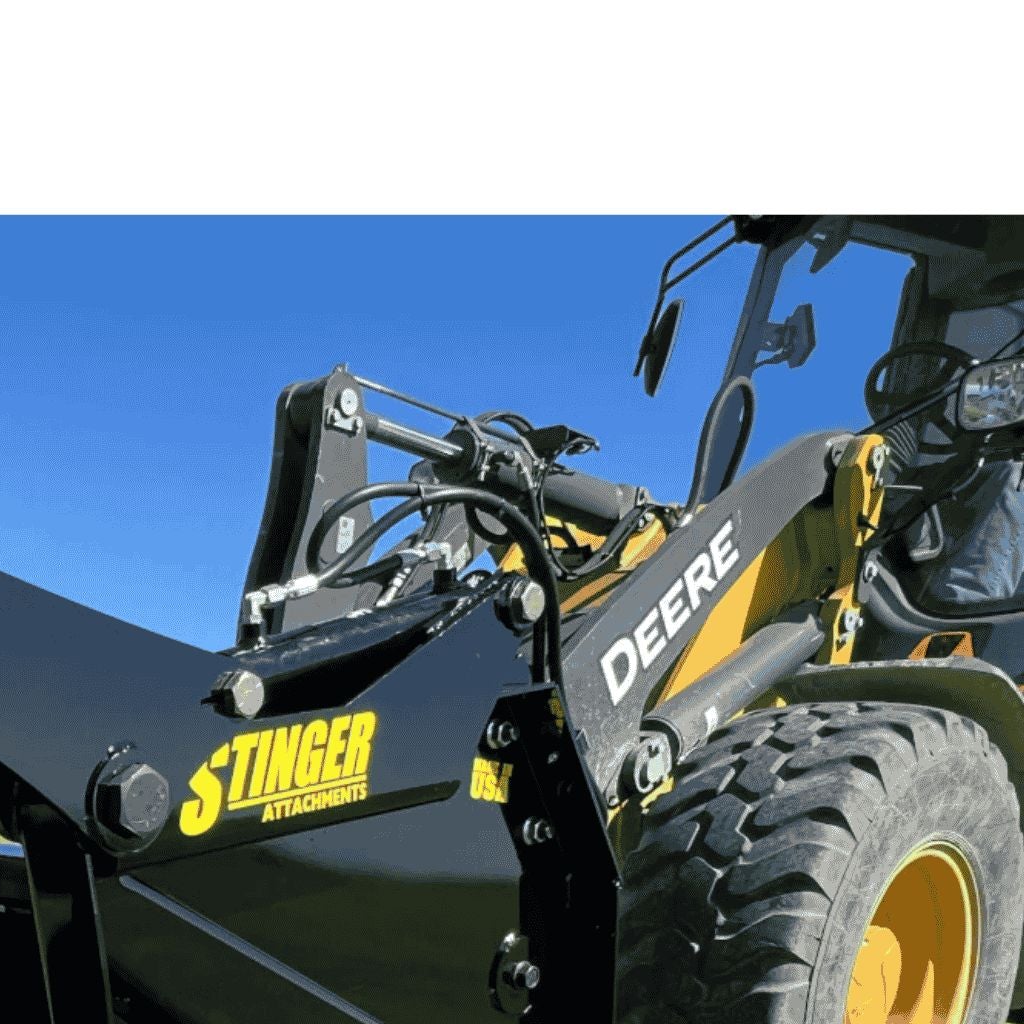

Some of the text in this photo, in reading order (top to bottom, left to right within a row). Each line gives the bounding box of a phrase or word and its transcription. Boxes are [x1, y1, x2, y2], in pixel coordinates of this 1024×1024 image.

[600, 518, 739, 707] DEERE
[179, 711, 377, 836] STINGER
[261, 782, 368, 823] ATTACHMENTS
